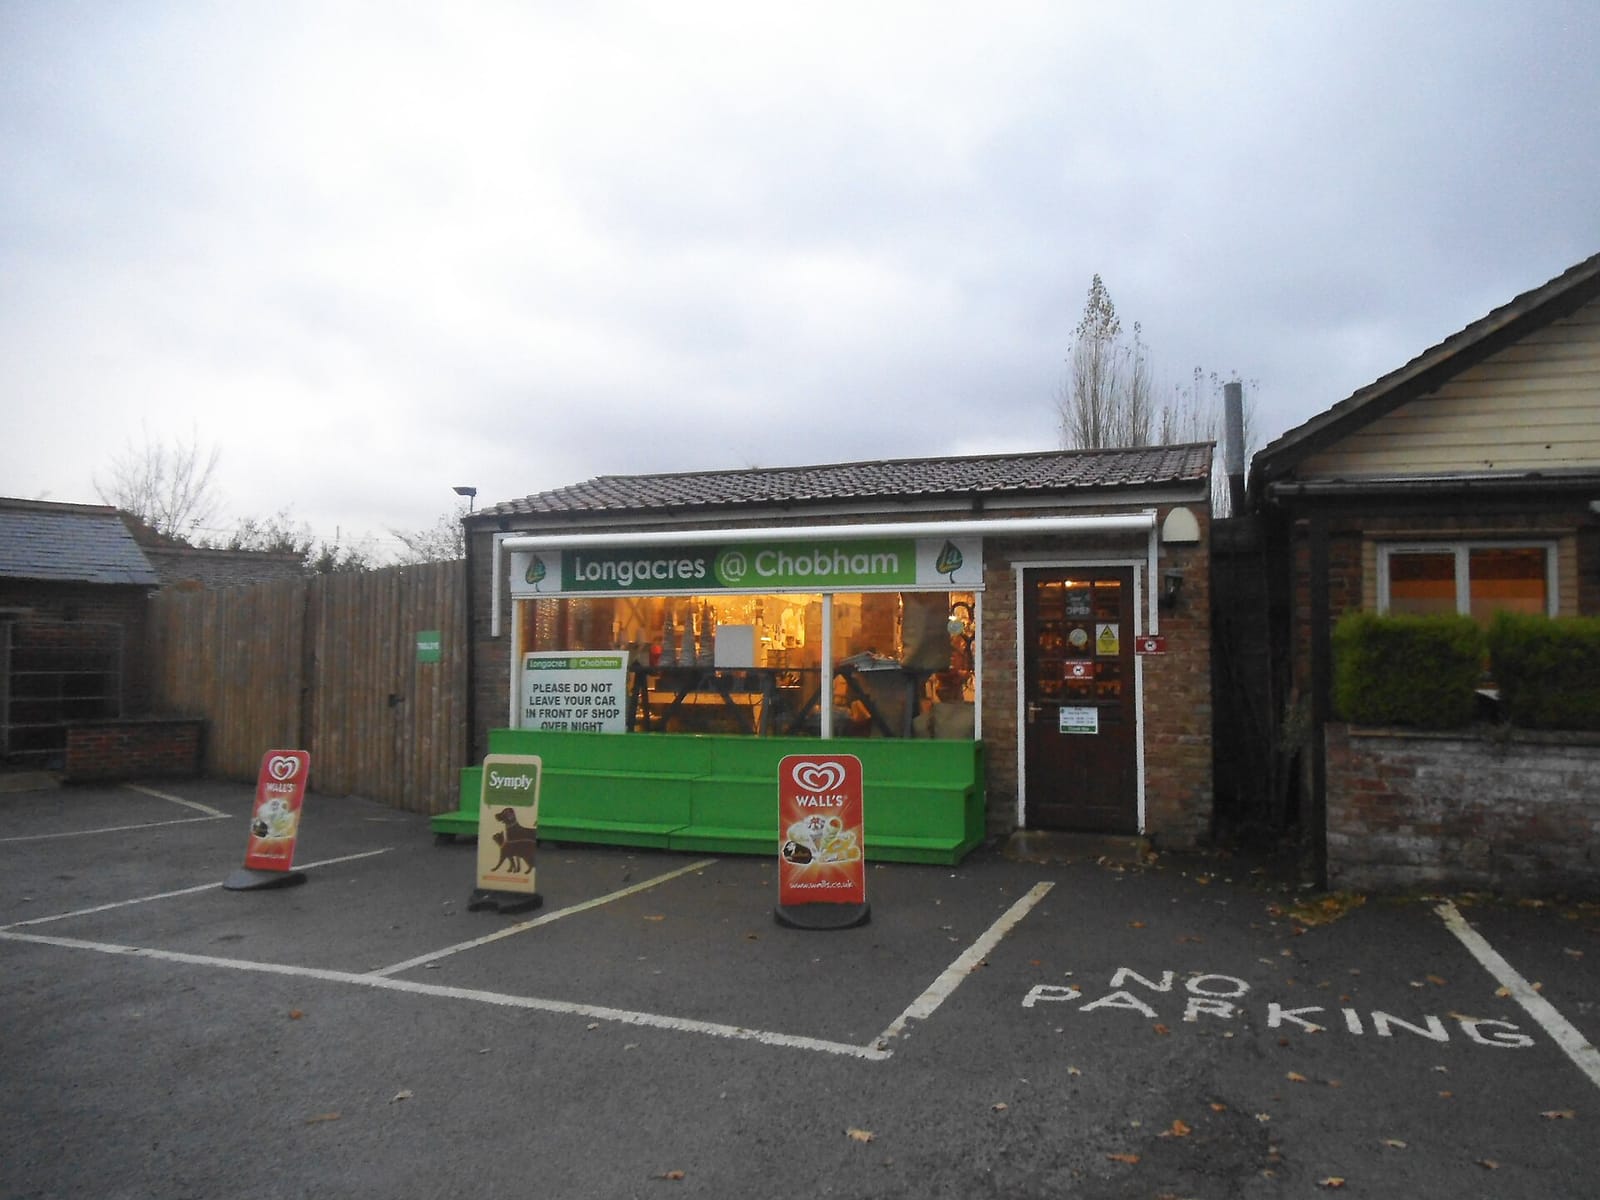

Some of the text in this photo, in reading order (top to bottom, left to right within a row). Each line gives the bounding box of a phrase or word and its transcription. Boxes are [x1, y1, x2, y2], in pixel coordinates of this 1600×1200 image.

[575, 557, 706, 586] Longacres
[720, 552, 747, 582] @
[755, 549, 898, 576] Chobham
[533, 683, 613, 693] PLEASE DO NOT
[529, 696, 616, 706] LEAVE YOUR CAR
[526, 708, 620, 719] IN FRONT OF SHOP
[540, 721, 604, 732] OVER NIGHT
[489, 771, 533, 790] Symply
[266, 782, 294, 793] WALL'S
[795, 795, 844, 807] WALL'S
[1110, 967, 1250, 998] NO
[1022, 984, 1535, 1049] PARKING
